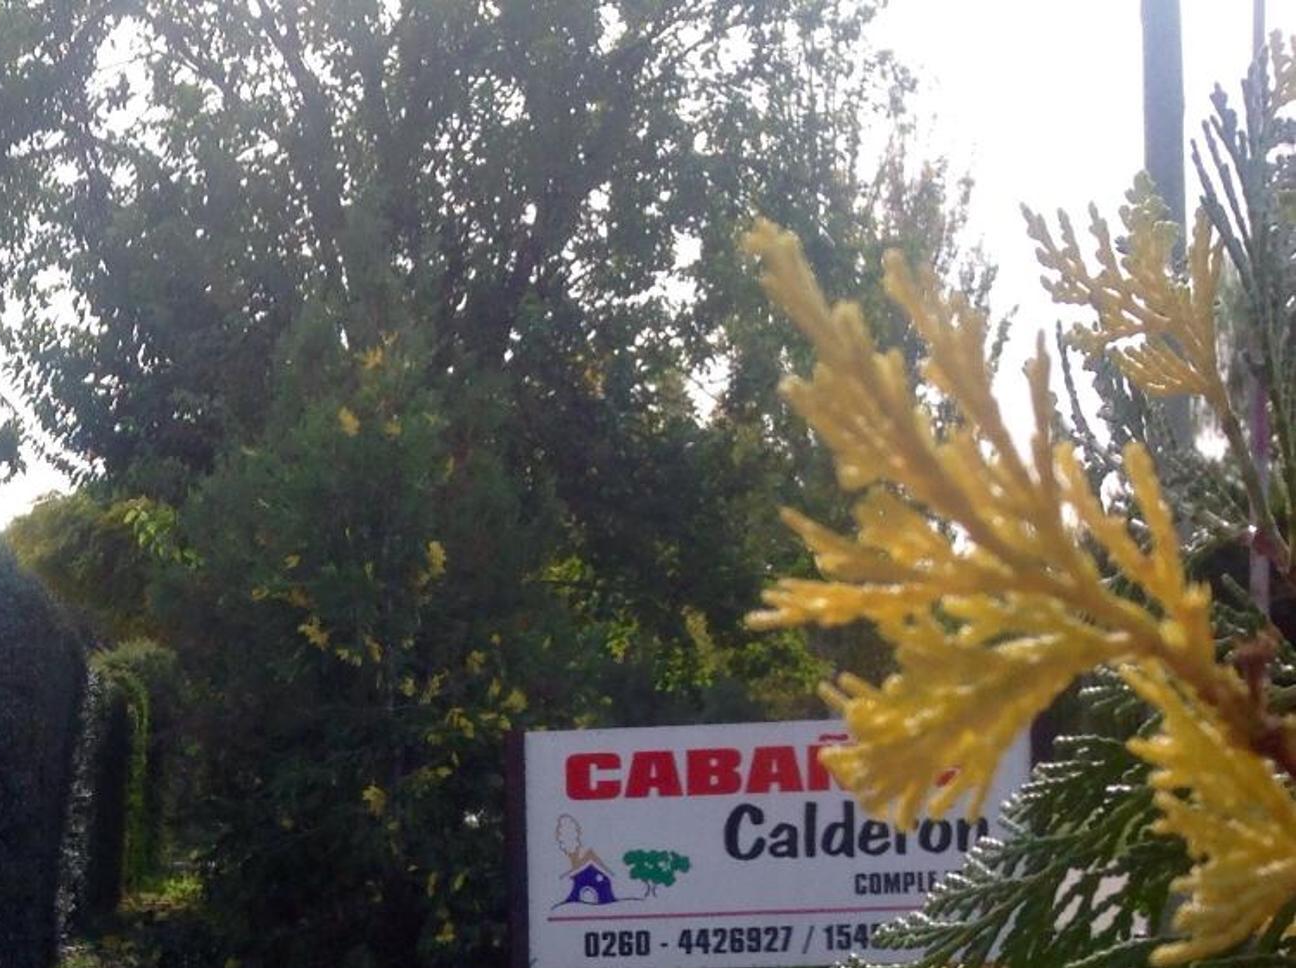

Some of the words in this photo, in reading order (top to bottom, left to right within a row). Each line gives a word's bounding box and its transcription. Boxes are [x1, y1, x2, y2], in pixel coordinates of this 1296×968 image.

[565, 734, 959, 801] CABAÑ
[584, 930, 651, 958] 0260
[677, 925, 795, 954] 4426927
